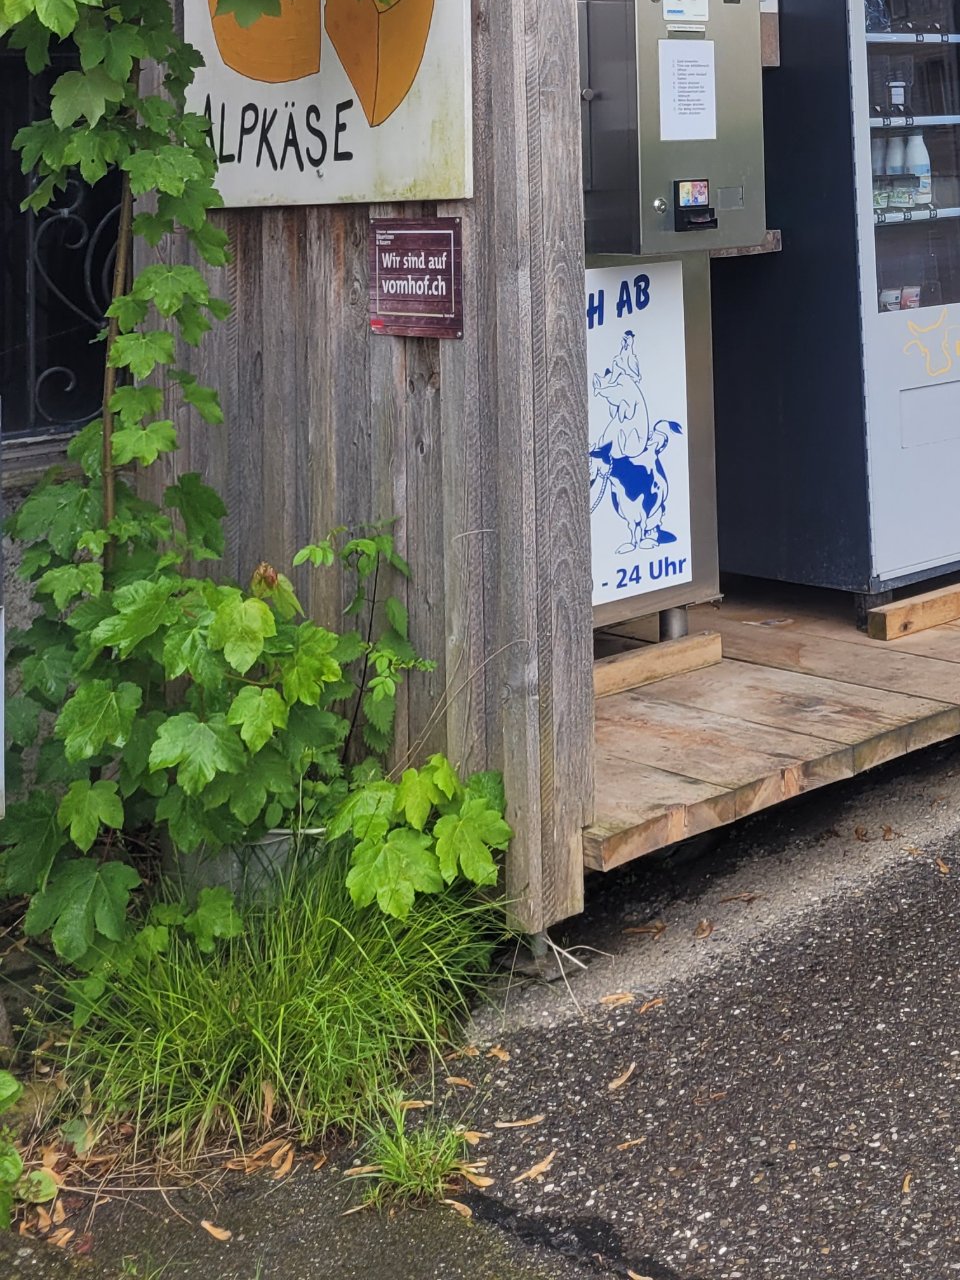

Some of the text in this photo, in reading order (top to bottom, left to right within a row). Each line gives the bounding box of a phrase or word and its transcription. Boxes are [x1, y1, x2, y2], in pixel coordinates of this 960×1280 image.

[382, 251, 448, 270] Wir sind auf
[382, 274, 447, 296] vomhof.ch
[616, 273, 650, 318] AB
[616, 564, 642, 590] 24
[649, 556, 687, 580] Uhr
